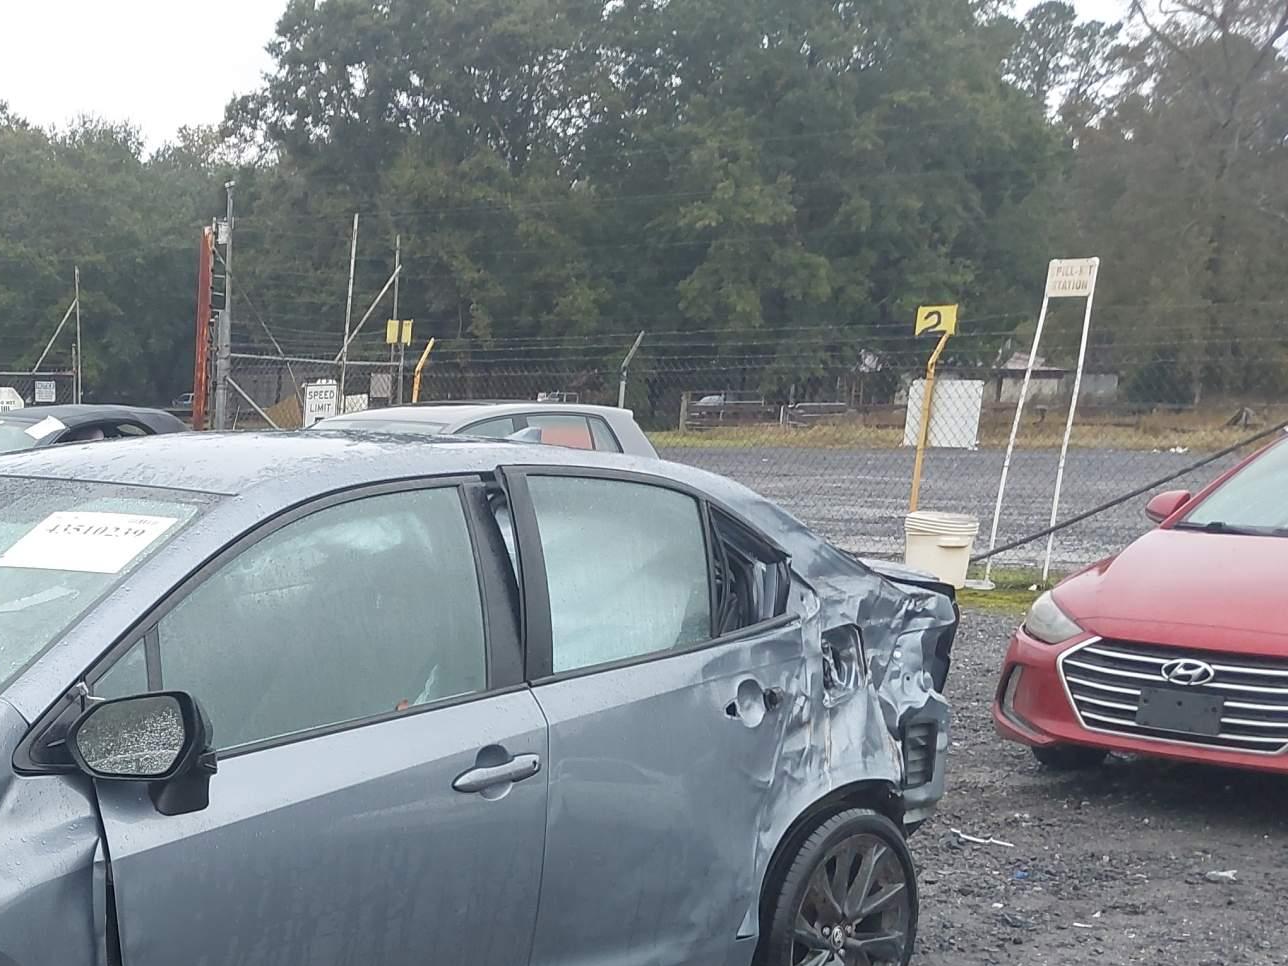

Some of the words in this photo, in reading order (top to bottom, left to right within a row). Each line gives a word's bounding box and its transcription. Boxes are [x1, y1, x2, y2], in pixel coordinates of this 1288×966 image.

[919, 310, 946, 335] 2
[308, 390, 335, 400] SPEED
[309, 403, 331, 412] LIMIT
